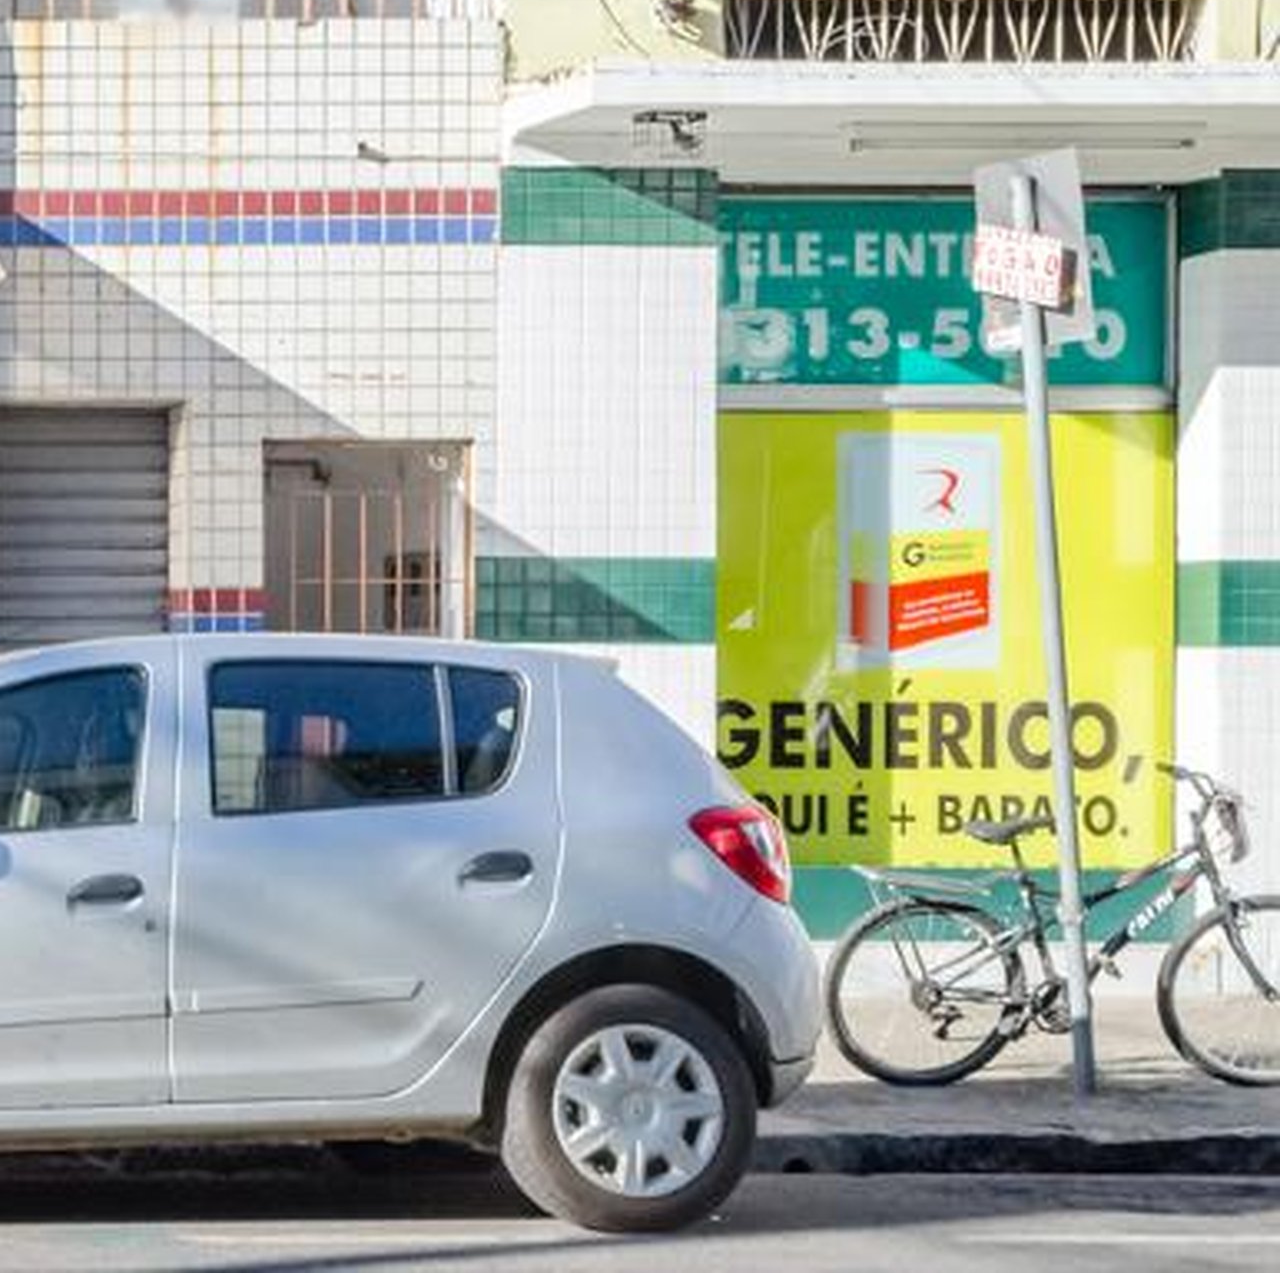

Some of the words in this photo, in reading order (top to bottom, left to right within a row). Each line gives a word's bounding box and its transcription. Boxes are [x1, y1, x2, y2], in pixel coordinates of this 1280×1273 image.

[903, 542, 925, 567] G
[716, 679, 1144, 783] GENÉRICO,
[848, 780, 868, 835] É
